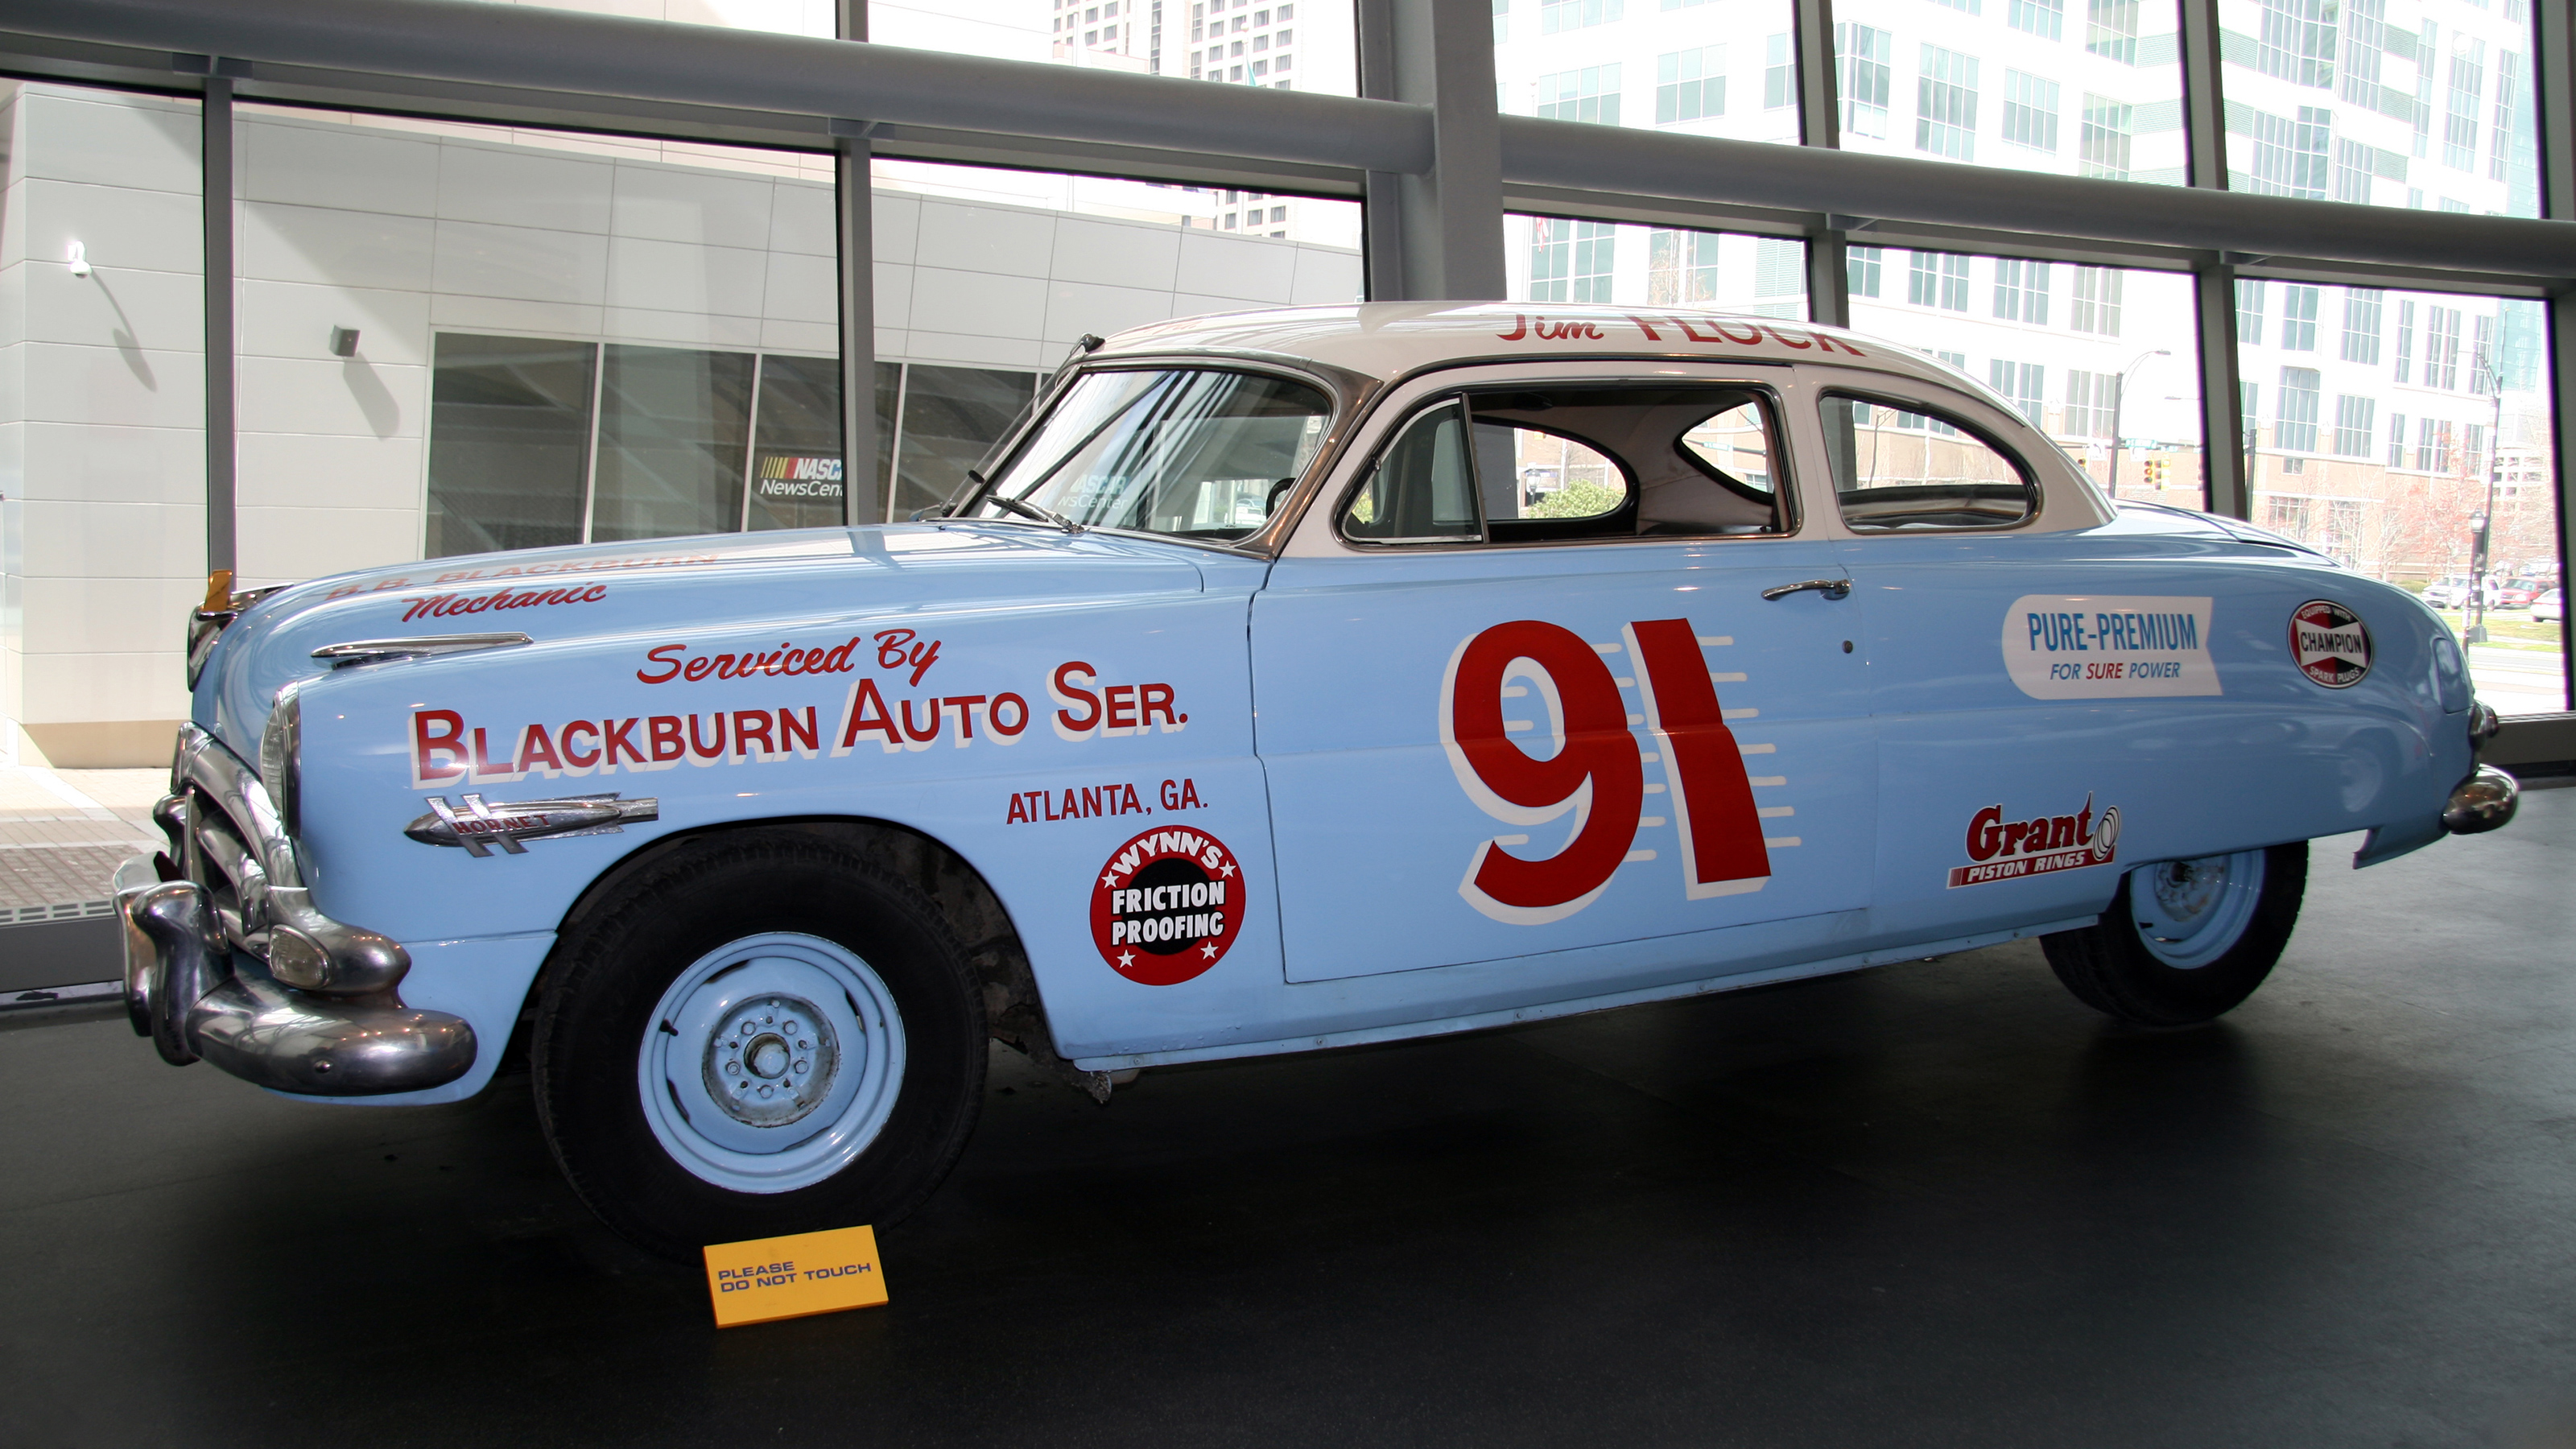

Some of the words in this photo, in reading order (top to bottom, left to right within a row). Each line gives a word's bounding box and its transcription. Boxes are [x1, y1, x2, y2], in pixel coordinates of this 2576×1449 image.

[1496, 314, 1604, 341] Jim
[1624, 315, 1867, 357] FLOCK
[434, 554, 720, 584] BLACKBURN
[401, 582, 607, 623] Mechanic
[2301, 605, 2331, 619] EQUIPPED
[2332, 607, 2351, 621] WITH
[2027, 613, 2198, 651] PURE-PREMIUM
[2300, 631, 2363, 653] CHAMPION
[637, 637, 861, 683] Serviced
[873, 629, 942, 687] By
[2050, 663, 2082, 680] FOR
[2086, 663, 2124, 679] SURE
[2128, 662, 2181, 679] POWER
[2309, 666, 2334, 683] SPARK
[2337, 667, 2359, 683] PLUGS
[409, 706, 819, 789] BLACKBURN
[829, 678, 1029, 758] AUTO
[1046, 661, 1189, 742] SER.
[1439, 618, 1772, 925] 91
[1006, 783, 1152, 824] ATLANTA,
[1160, 778, 1209, 811] GA.
[452, 813, 551, 835] HORNET
[1966, 791, 2094, 862] Grant
[1111, 831, 1224, 875] WYNN'S
[1967, 862, 2027, 882] PISTON
[2033, 852, 2086, 872] RINGS
[1113, 881, 1224, 914] FRICTION
[1112, 911, 1224, 946] PROOFING
[718, 1261, 795, 1281] PLEASE
[720, 1279, 750, 1293] DO
[757, 1273, 798, 1288] NOT
[803, 1262, 872, 1281] TOUCH
